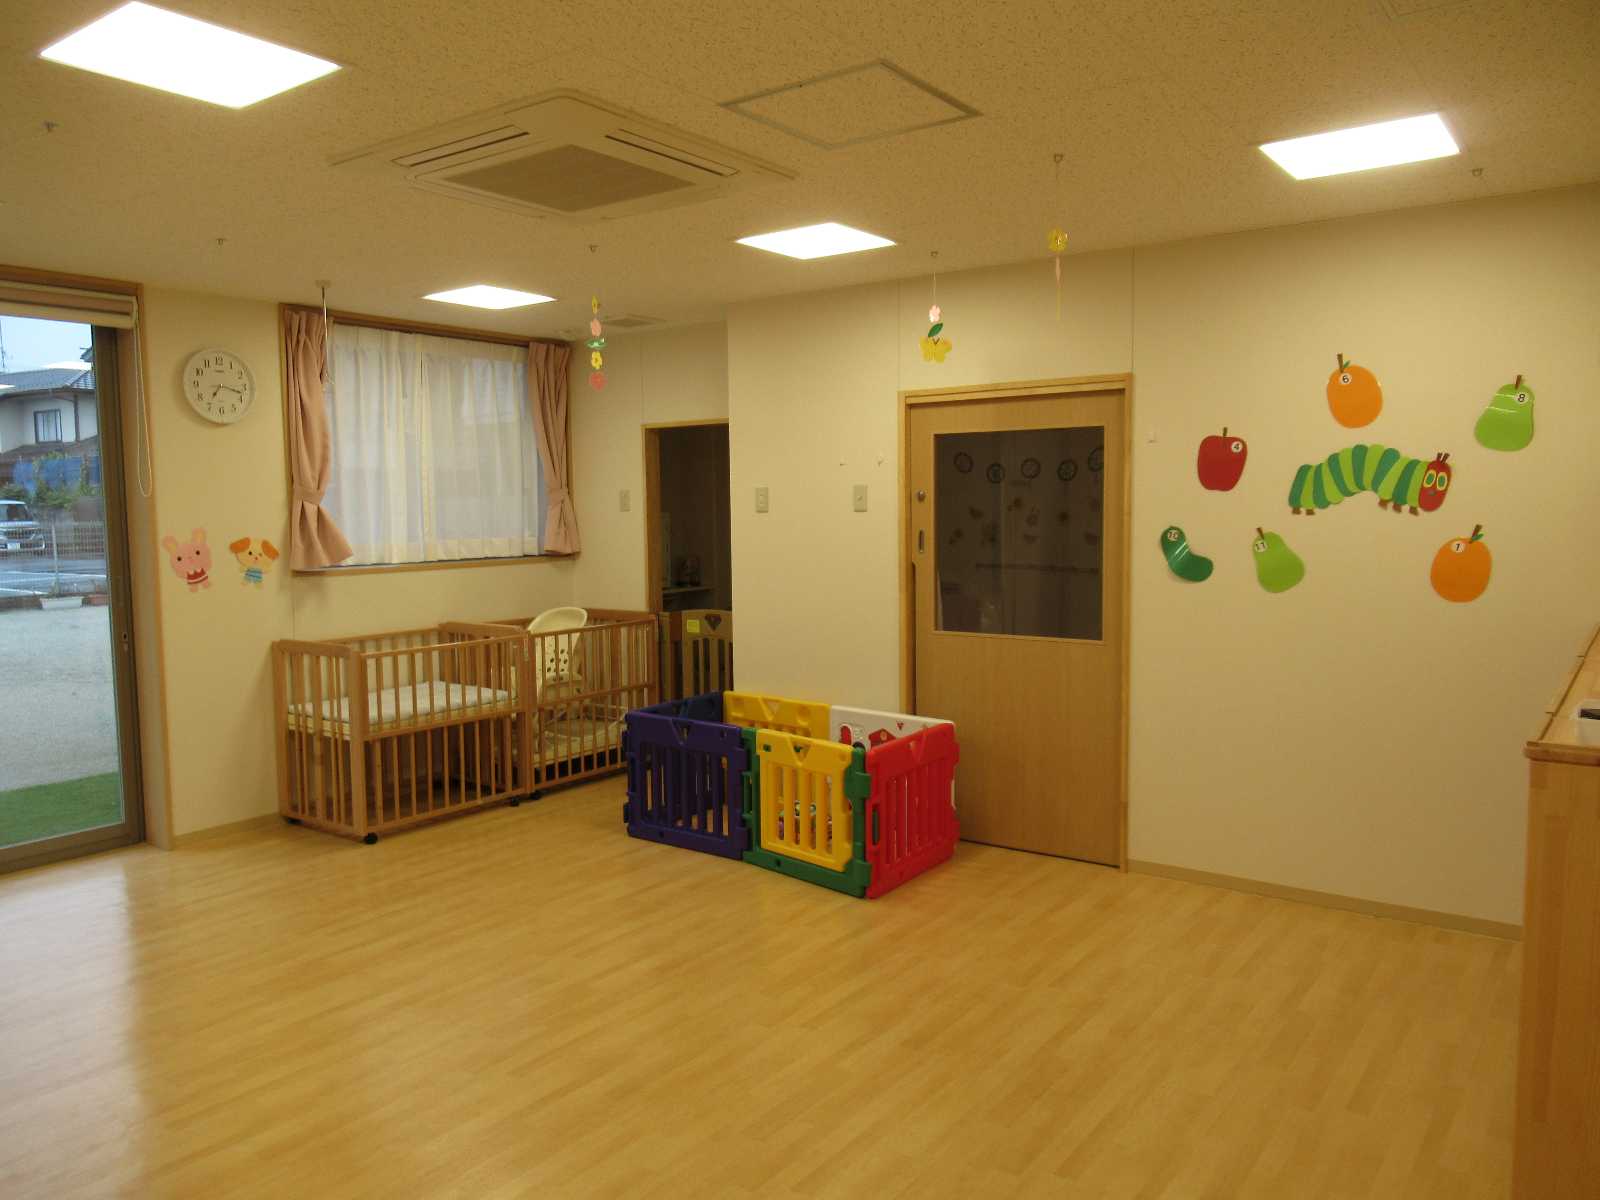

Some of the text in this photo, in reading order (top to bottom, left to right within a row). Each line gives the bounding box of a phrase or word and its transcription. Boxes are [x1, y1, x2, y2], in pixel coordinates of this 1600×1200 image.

[204, 359, 210, 369] 11
[215, 356, 224, 366] 12
[195, 367, 204, 377] 10
[1342, 375, 1350, 384] 6
[1517, 393, 1526, 403] 8
